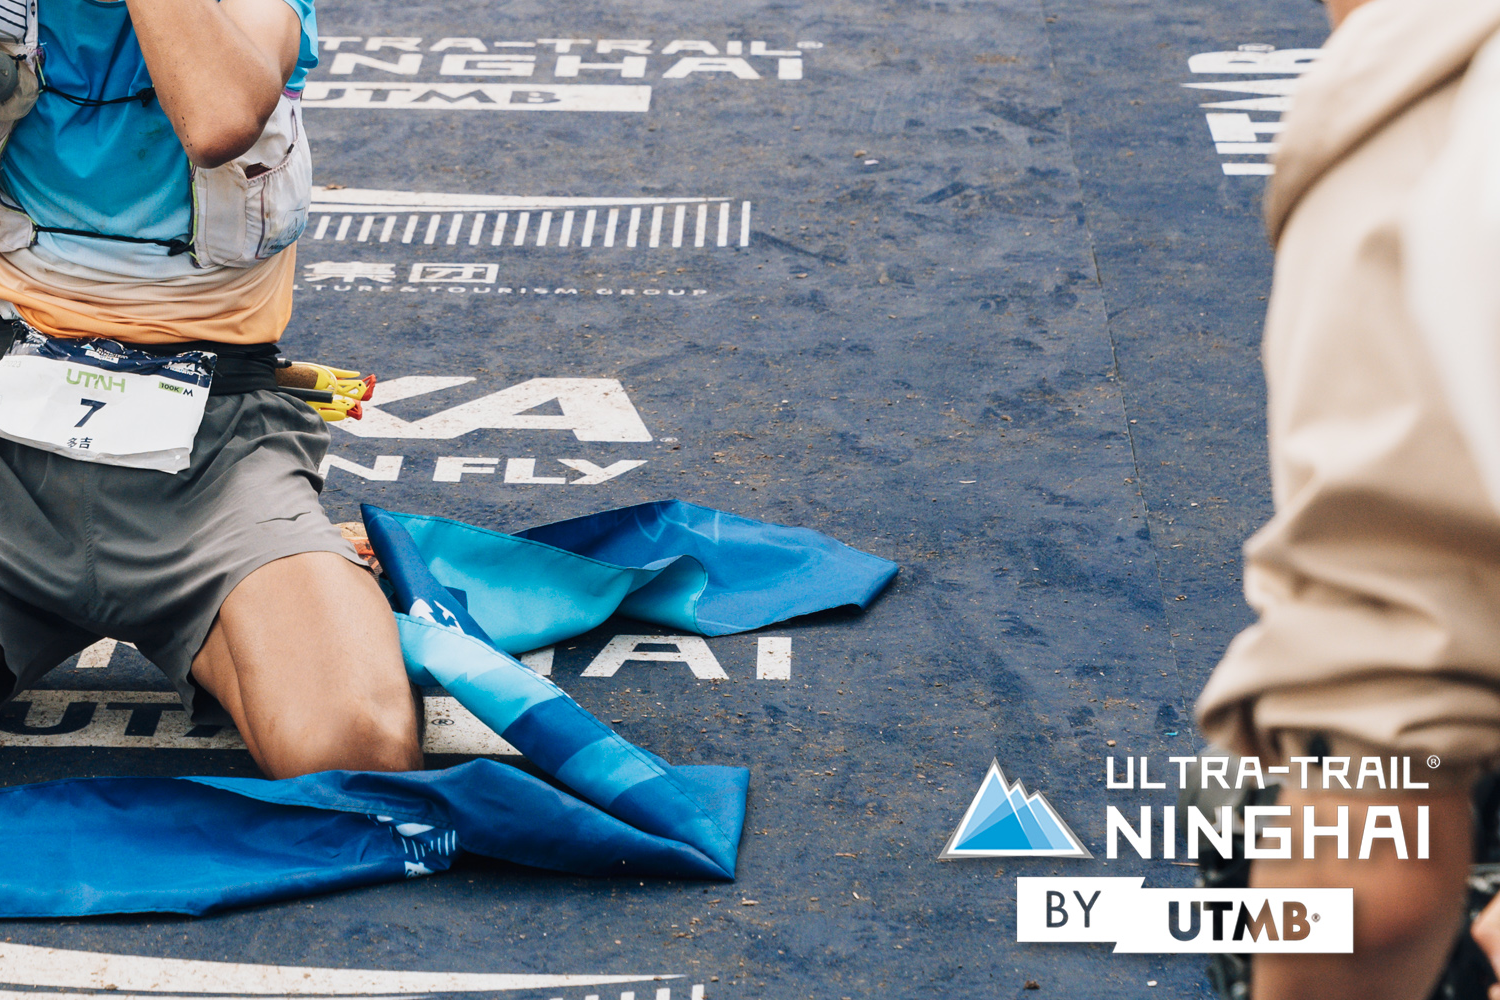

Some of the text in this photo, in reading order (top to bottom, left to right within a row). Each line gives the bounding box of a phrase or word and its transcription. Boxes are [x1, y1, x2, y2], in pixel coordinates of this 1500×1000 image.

[329, 53, 803, 80] NGHAI
[596, 287, 708, 297] GROUP
[73, 398, 107, 428] 7
[66, 436, 93, 450] 多吉
[432, 457, 649, 485] FLY
